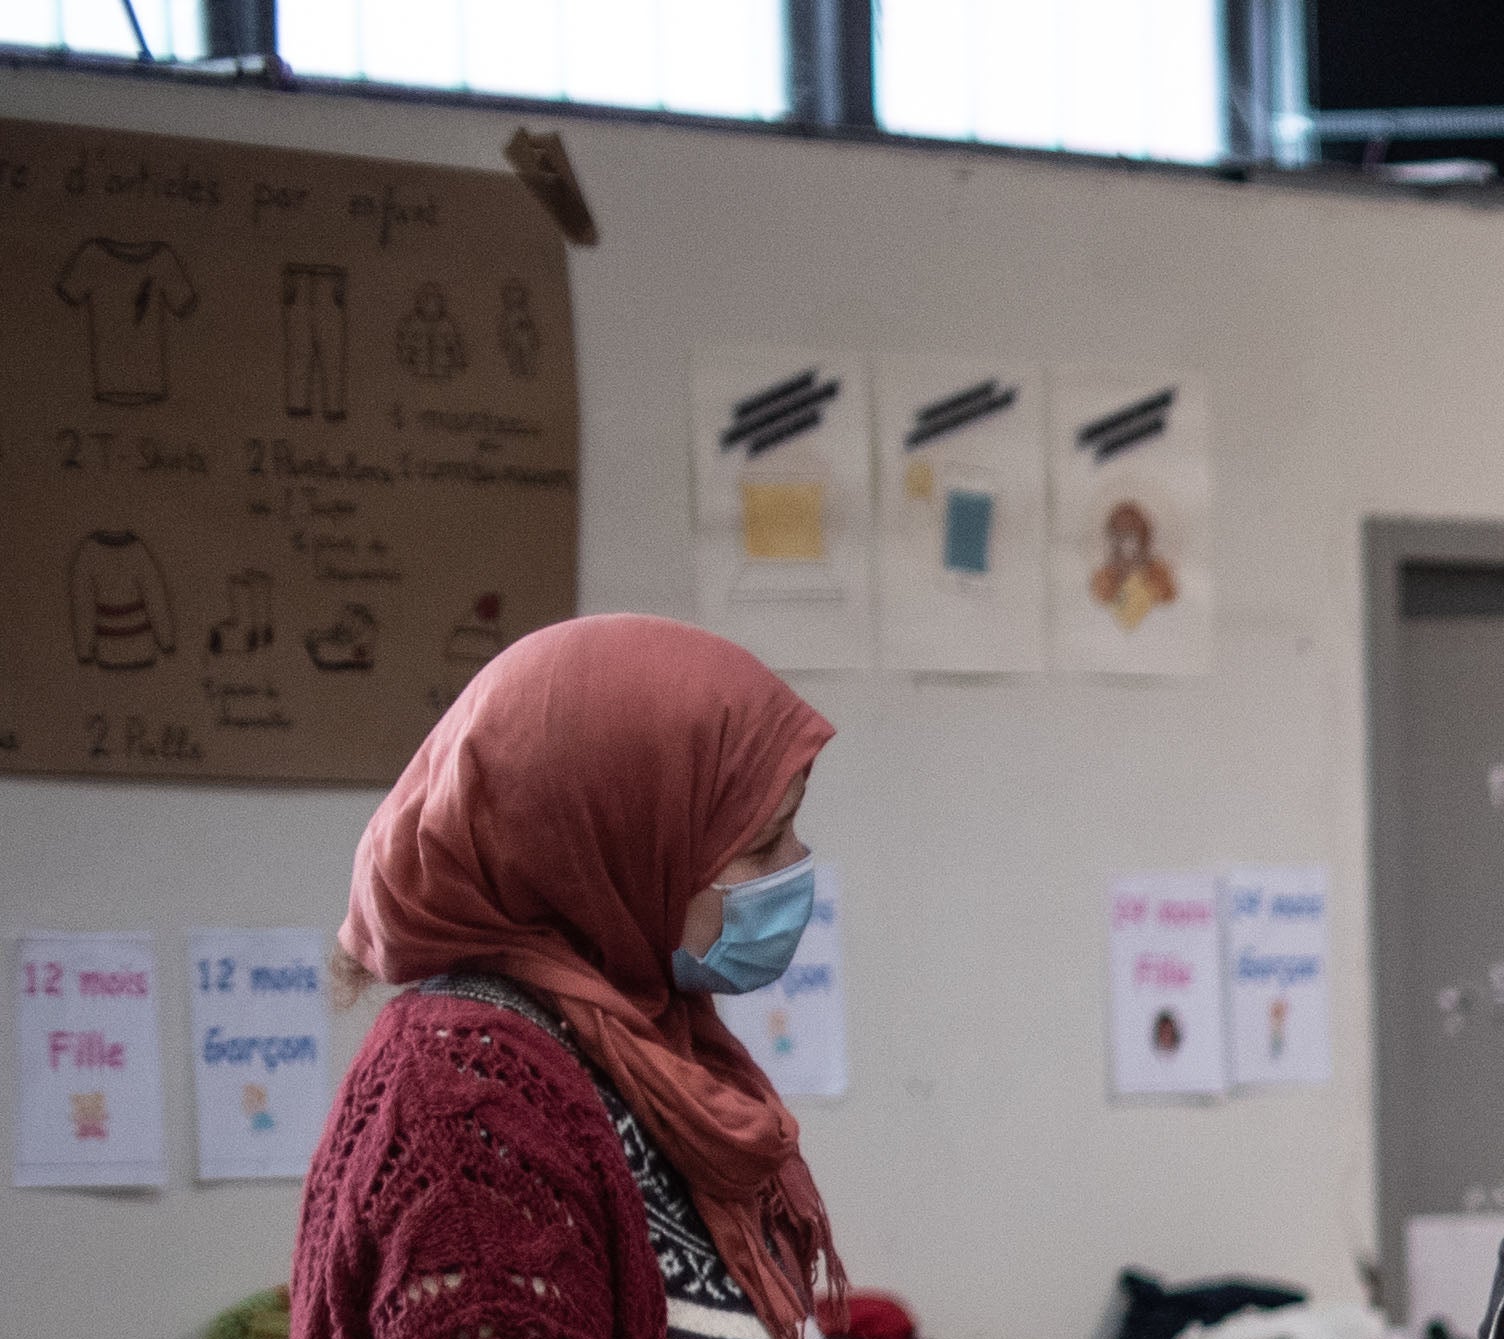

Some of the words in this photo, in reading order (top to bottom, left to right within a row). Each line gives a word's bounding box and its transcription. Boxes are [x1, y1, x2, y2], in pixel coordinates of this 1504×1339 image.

[60, 428, 83, 471] 2
[85, 713, 111, 760] 2
[23, 960, 63, 997] 12
[78, 963, 149, 997] mois
[198, 957, 237, 993] 12
[249, 958, 319, 994] mois
[48, 1029, 126, 1071] Fille
[202, 1026, 318, 1073] Garçon
